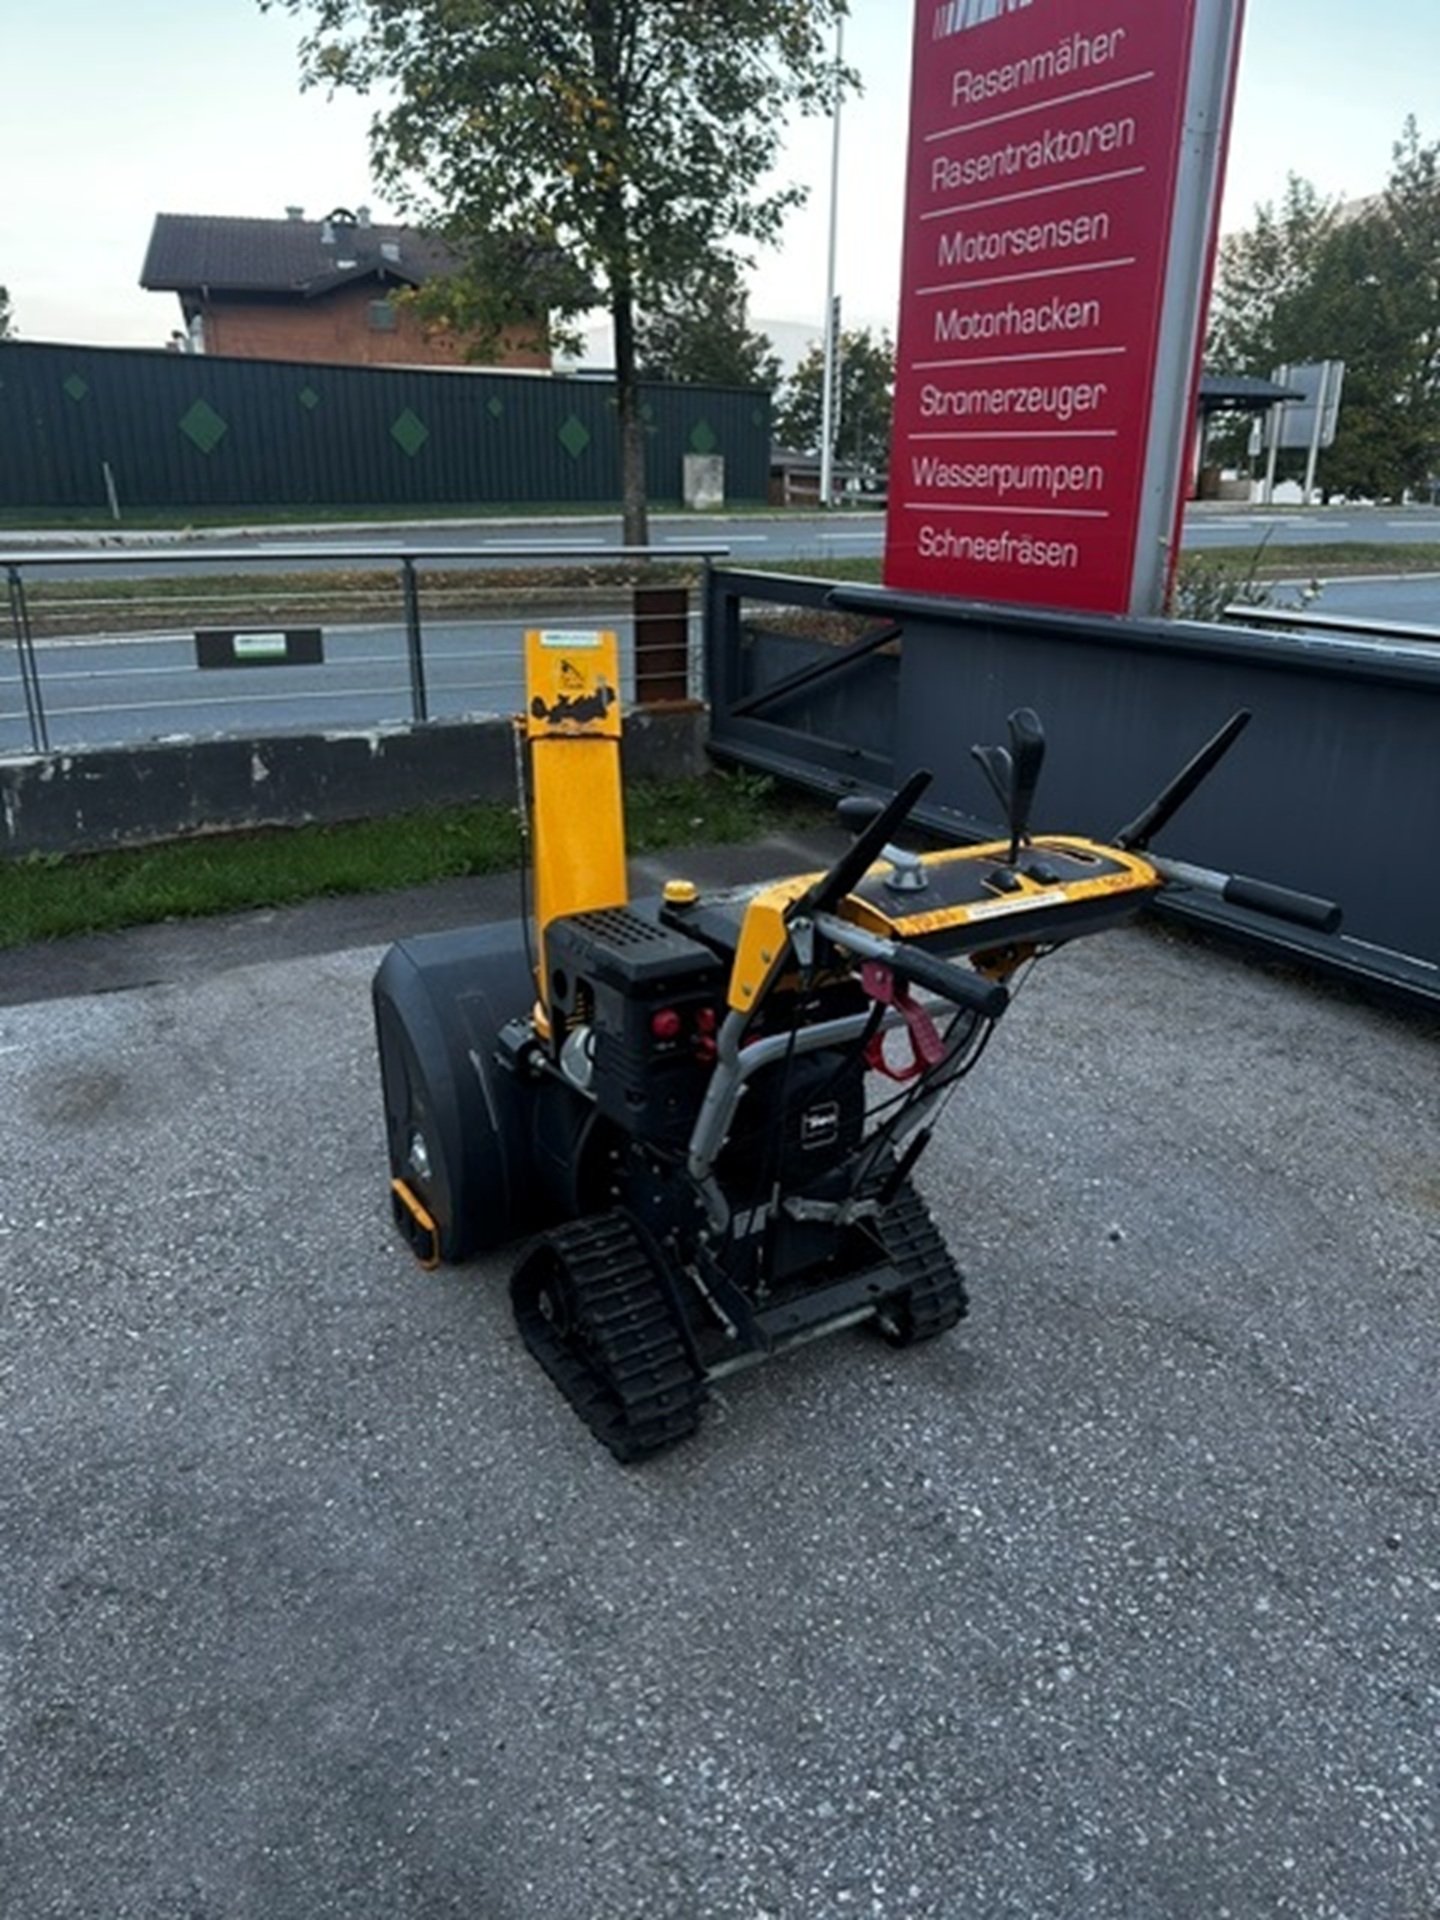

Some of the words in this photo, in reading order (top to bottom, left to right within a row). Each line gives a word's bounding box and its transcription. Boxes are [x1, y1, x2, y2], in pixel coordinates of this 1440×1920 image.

[952, 27, 1126, 107] Rasenmäher
[931, 117, 1136, 192] Rasentraktoren
[937, 212, 1109, 267] Motorsensen
[934, 297, 1101, 342] Motorhacken
[919, 383, 1108, 420] Stromerzeuger
[911, 457, 1103, 497] Wasserpumpen
[918, 525, 1079, 567] Schneefräsen
